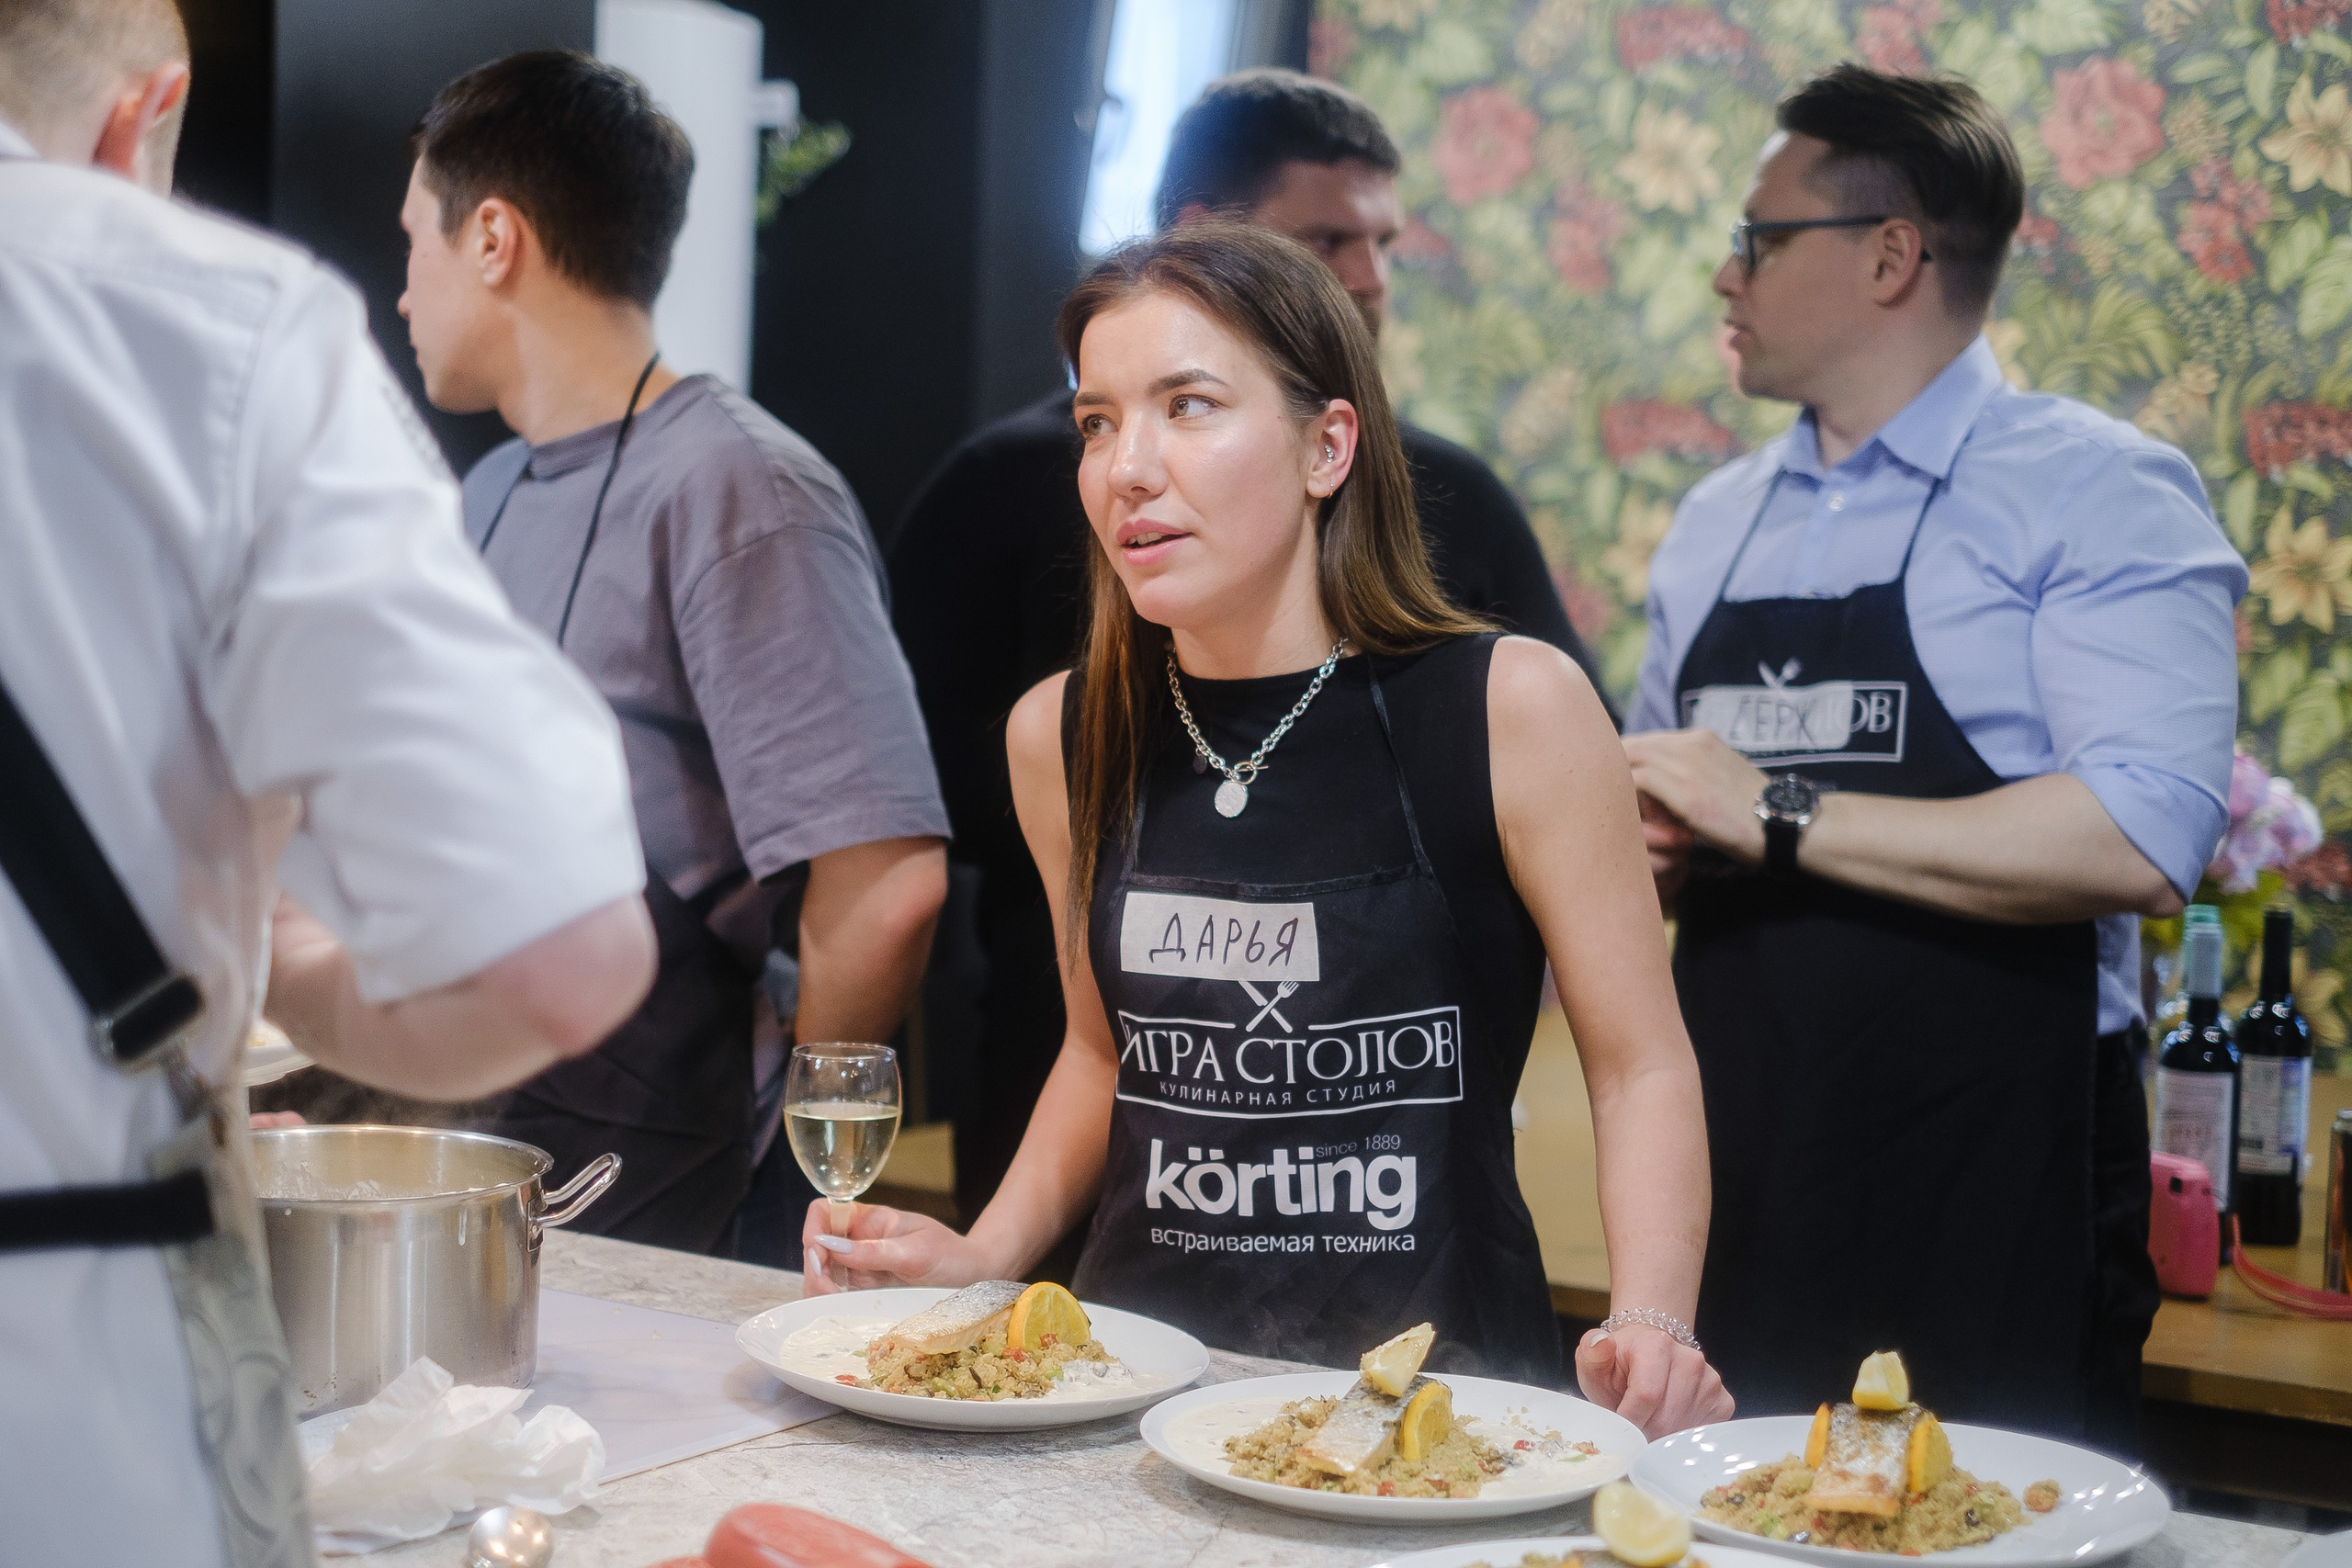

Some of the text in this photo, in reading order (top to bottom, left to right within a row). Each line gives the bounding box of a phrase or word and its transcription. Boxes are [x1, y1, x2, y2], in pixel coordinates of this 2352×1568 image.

[1148, 912, 1299, 967] ДАРЬЯ
[1121, 1021, 1454, 1084] ИГРА СТОЛОВ
[1159, 1078, 1396, 1106] КУЛИНАРНАЯ СТУДИЯ
[1316, 1134, 1401, 1158] since 1889
[1146, 1138, 1417, 1231] körting
[1151, 1227, 1415, 1253] встраиваемая техника
